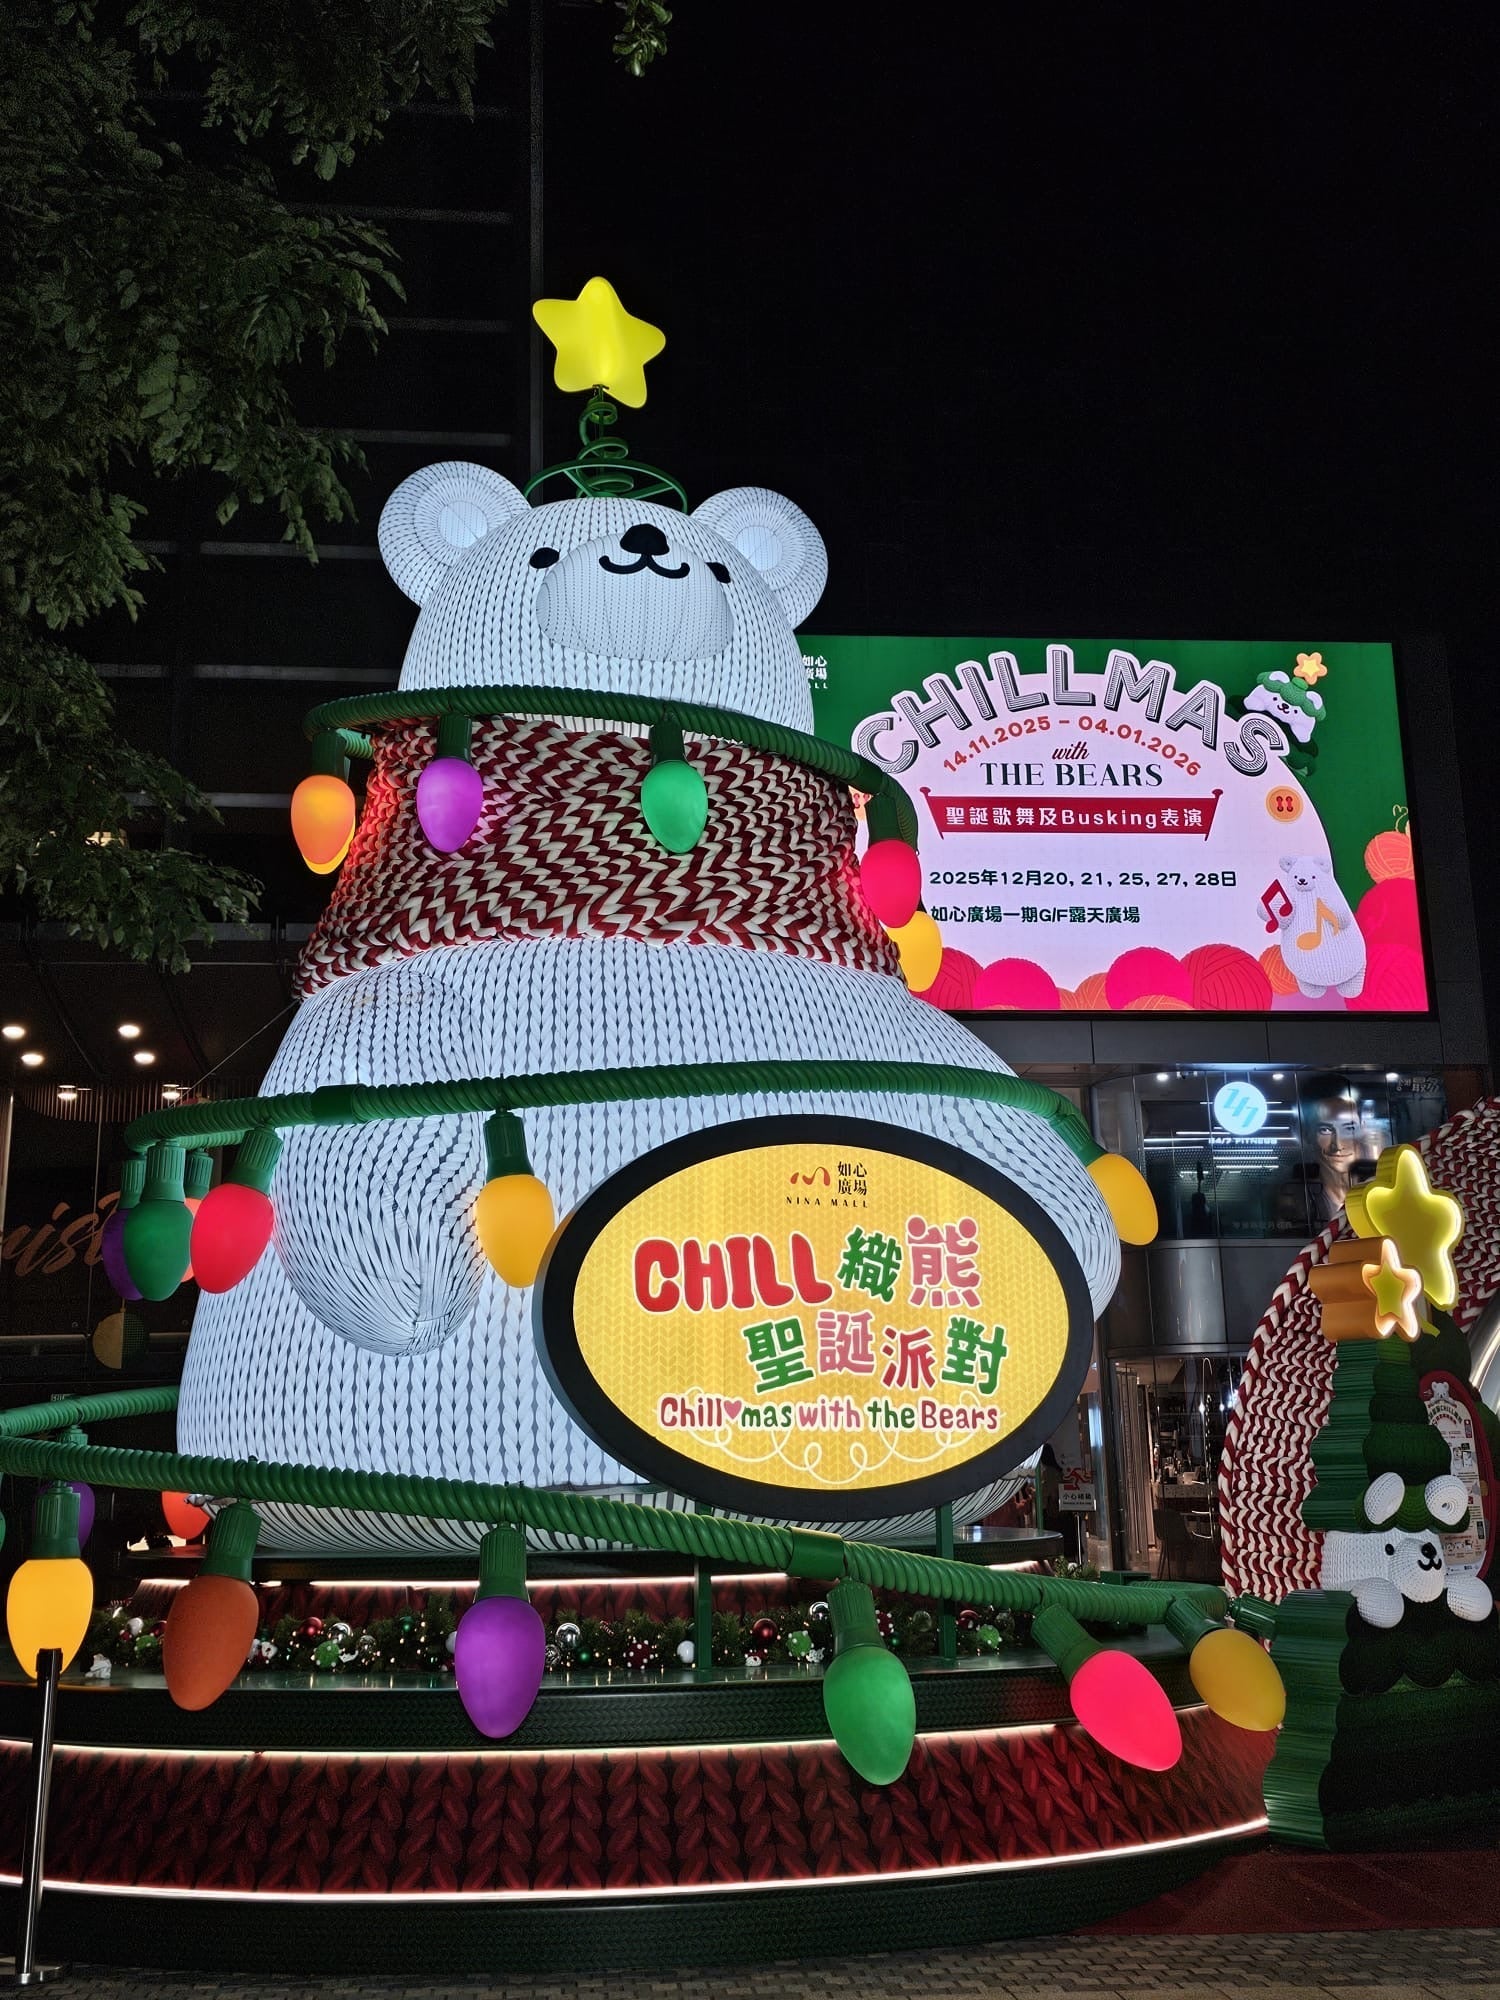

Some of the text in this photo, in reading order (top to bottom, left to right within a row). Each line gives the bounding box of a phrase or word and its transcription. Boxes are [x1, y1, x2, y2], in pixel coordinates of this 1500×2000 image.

[857, 649, 1284, 777] CHILLMAS
[943, 715, 1051, 772] 14.11.2025
[1078, 715, 1202, 776] 04.01.2026
[1051, 741, 1090, 760] with
[980, 762, 1163, 787] THE BEARS
[946, 806, 1203, 829] 聖誕歌舞及Busking表演
[1194, 871, 1237, 887] 28日
[931, 905, 1141, 923] 如心廣場一期G/F露天廣場
[837, 1161, 868, 1177] 如心
[837, 1178, 868, 1195] 廣場
[785, 1196, 868, 1208] NINA MALL
[634, 1232, 833, 1313] CHILL
[743, 1311, 1008, 1394] 聖誕派對
[798, 1399, 861, 1429] with
[867, 1400, 916, 1429] the
[920, 1400, 998, 1430] Bears
